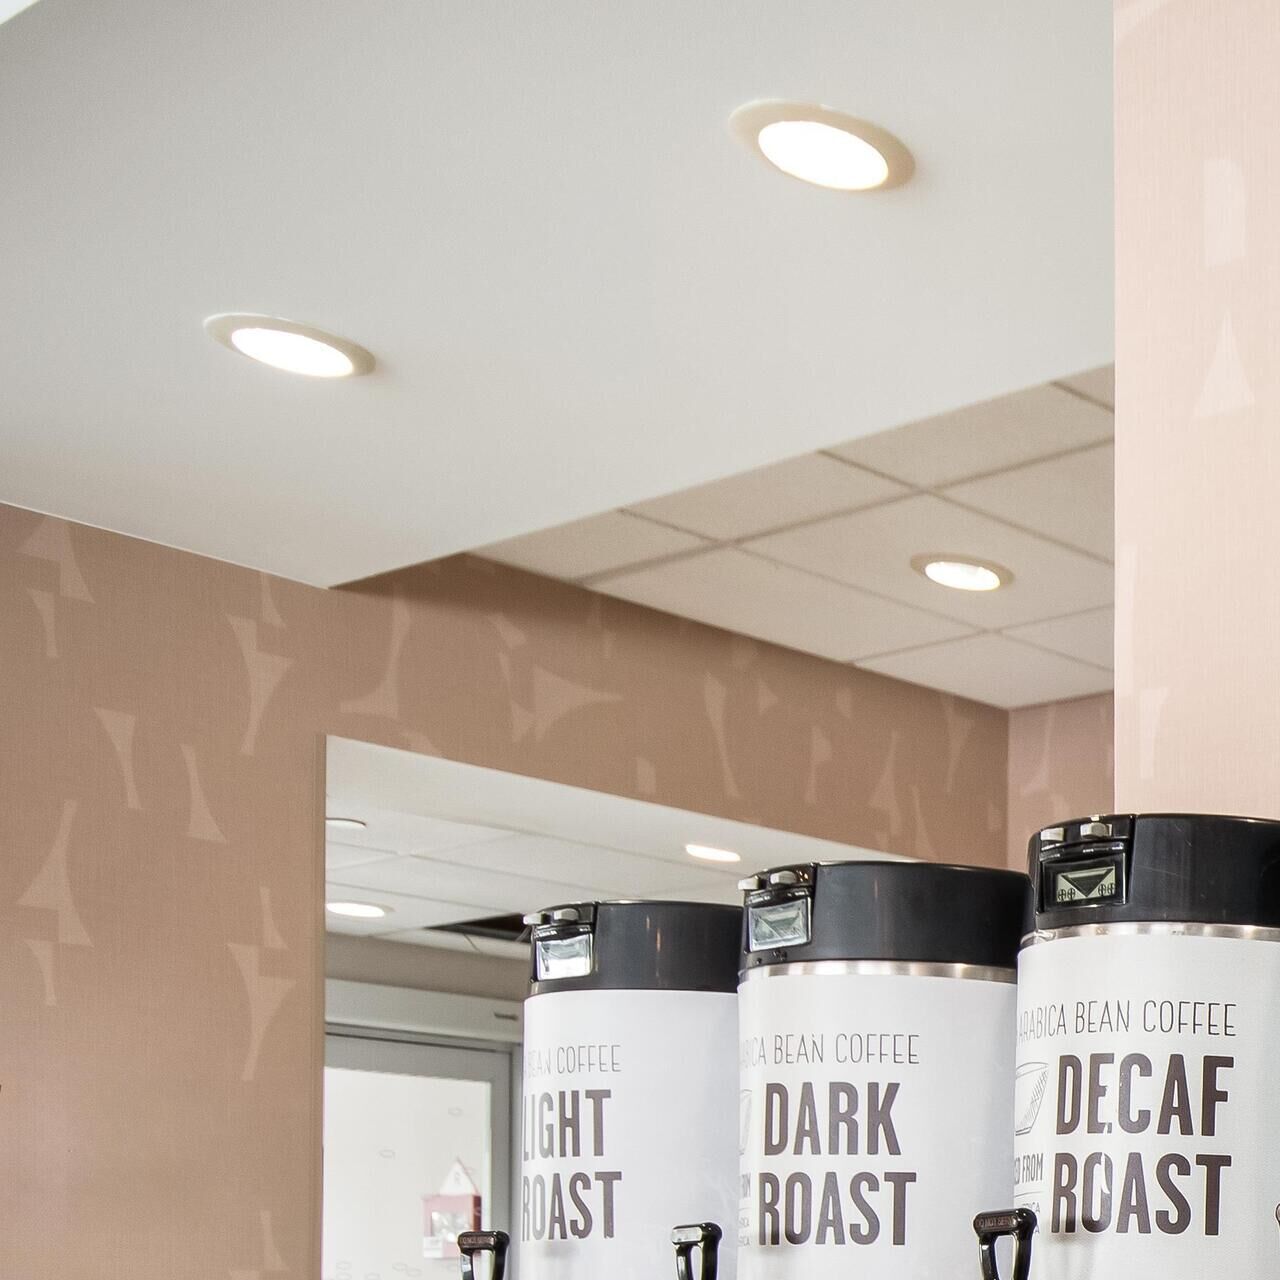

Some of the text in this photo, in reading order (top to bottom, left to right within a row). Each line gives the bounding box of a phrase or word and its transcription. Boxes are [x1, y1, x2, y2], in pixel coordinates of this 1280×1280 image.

[774, 1033, 824, 1065] BEAN
[835, 1033, 920, 1065] COFFEE
[1075, 999, 1130, 1035] BEAN
[1143, 1000, 1238, 1037] COFFEE
[556, 1045, 623, 1074] COFFEE
[1056, 1053, 1236, 1137] DECAF
[523, 1089, 612, 1162] LIGHT
[764, 1081, 902, 1156] DARK
[1021, 1152, 1044, 1183] FROM
[1051, 1151, 1233, 1237] ROAST
[522, 1171, 622, 1242] ROAST
[758, 1171, 917, 1246] ROAST
